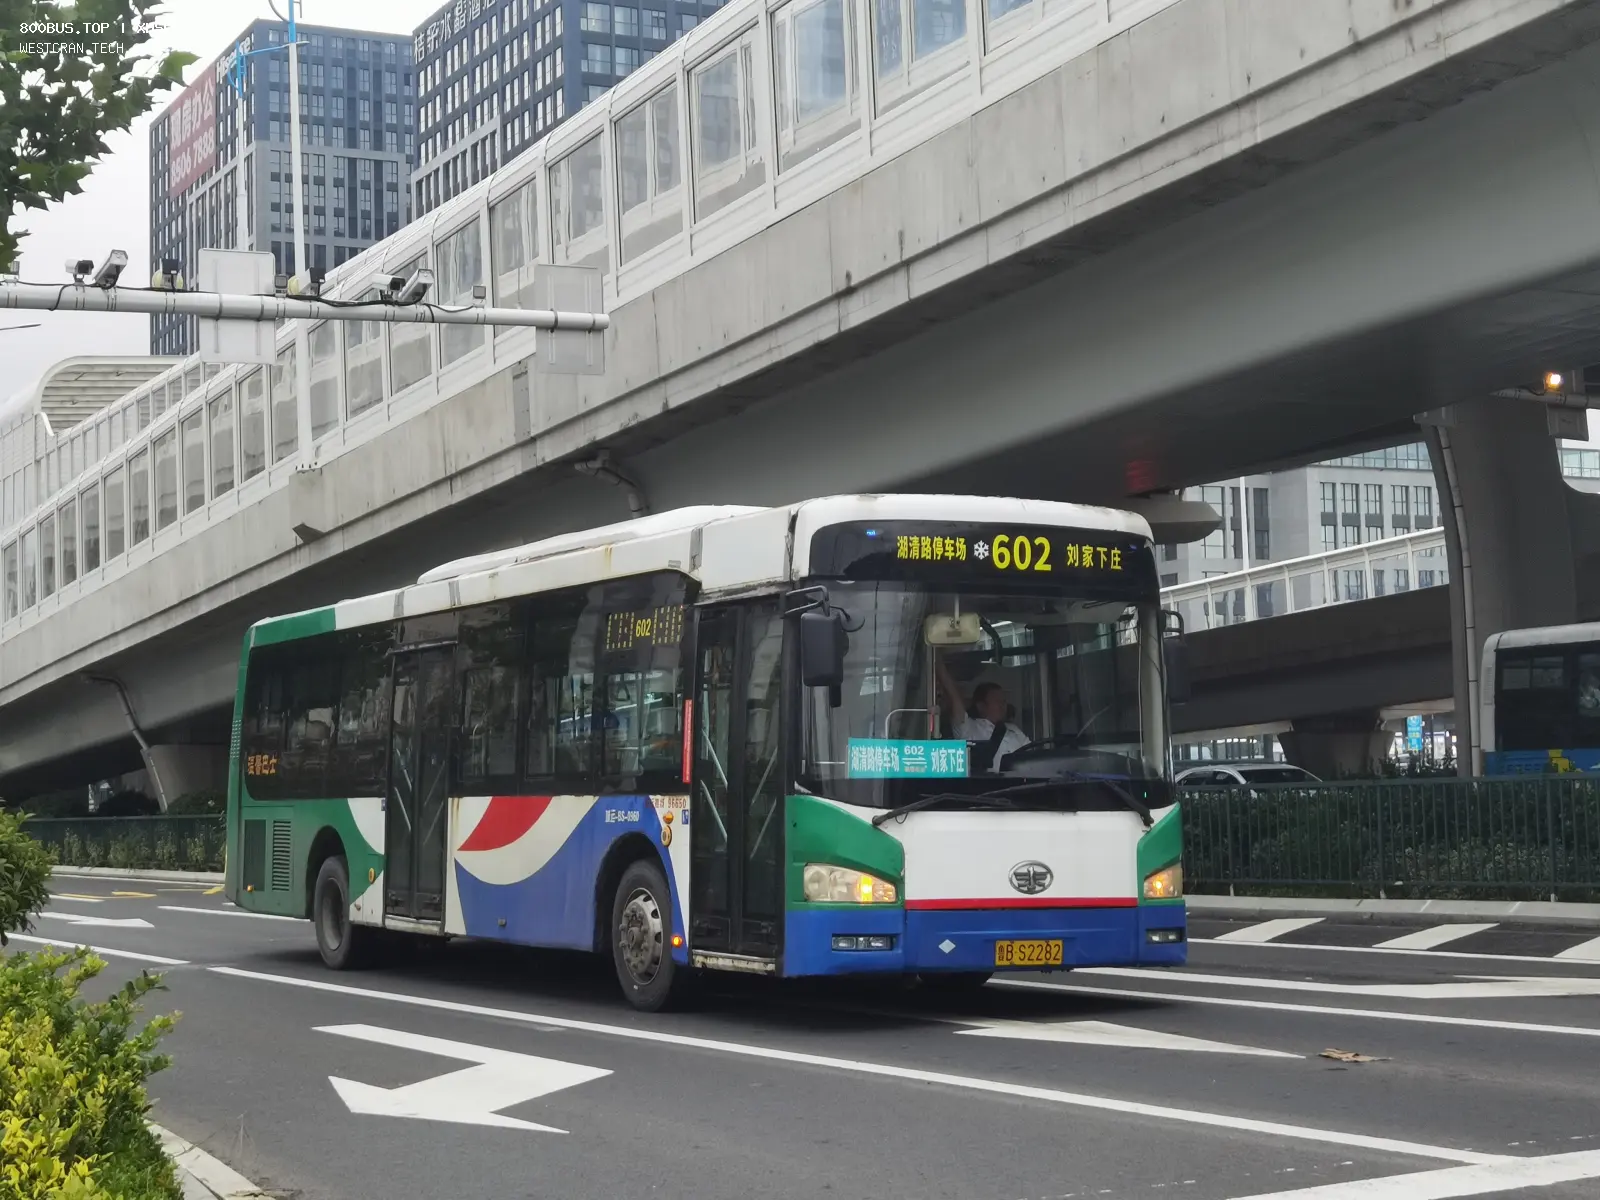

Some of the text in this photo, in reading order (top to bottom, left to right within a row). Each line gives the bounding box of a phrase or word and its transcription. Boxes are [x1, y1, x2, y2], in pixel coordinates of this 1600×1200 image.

[413, 0, 497, 65] 桔子水晶酒
[193, 127, 215, 169] 7888
[992, 534, 1052, 571] 602
[1066, 543, 1122, 570] 刘家下庄
[635, 618, 652, 637] 602
[903, 745, 925, 755] 602
[930, 747, 965, 773] 刘家下庄
